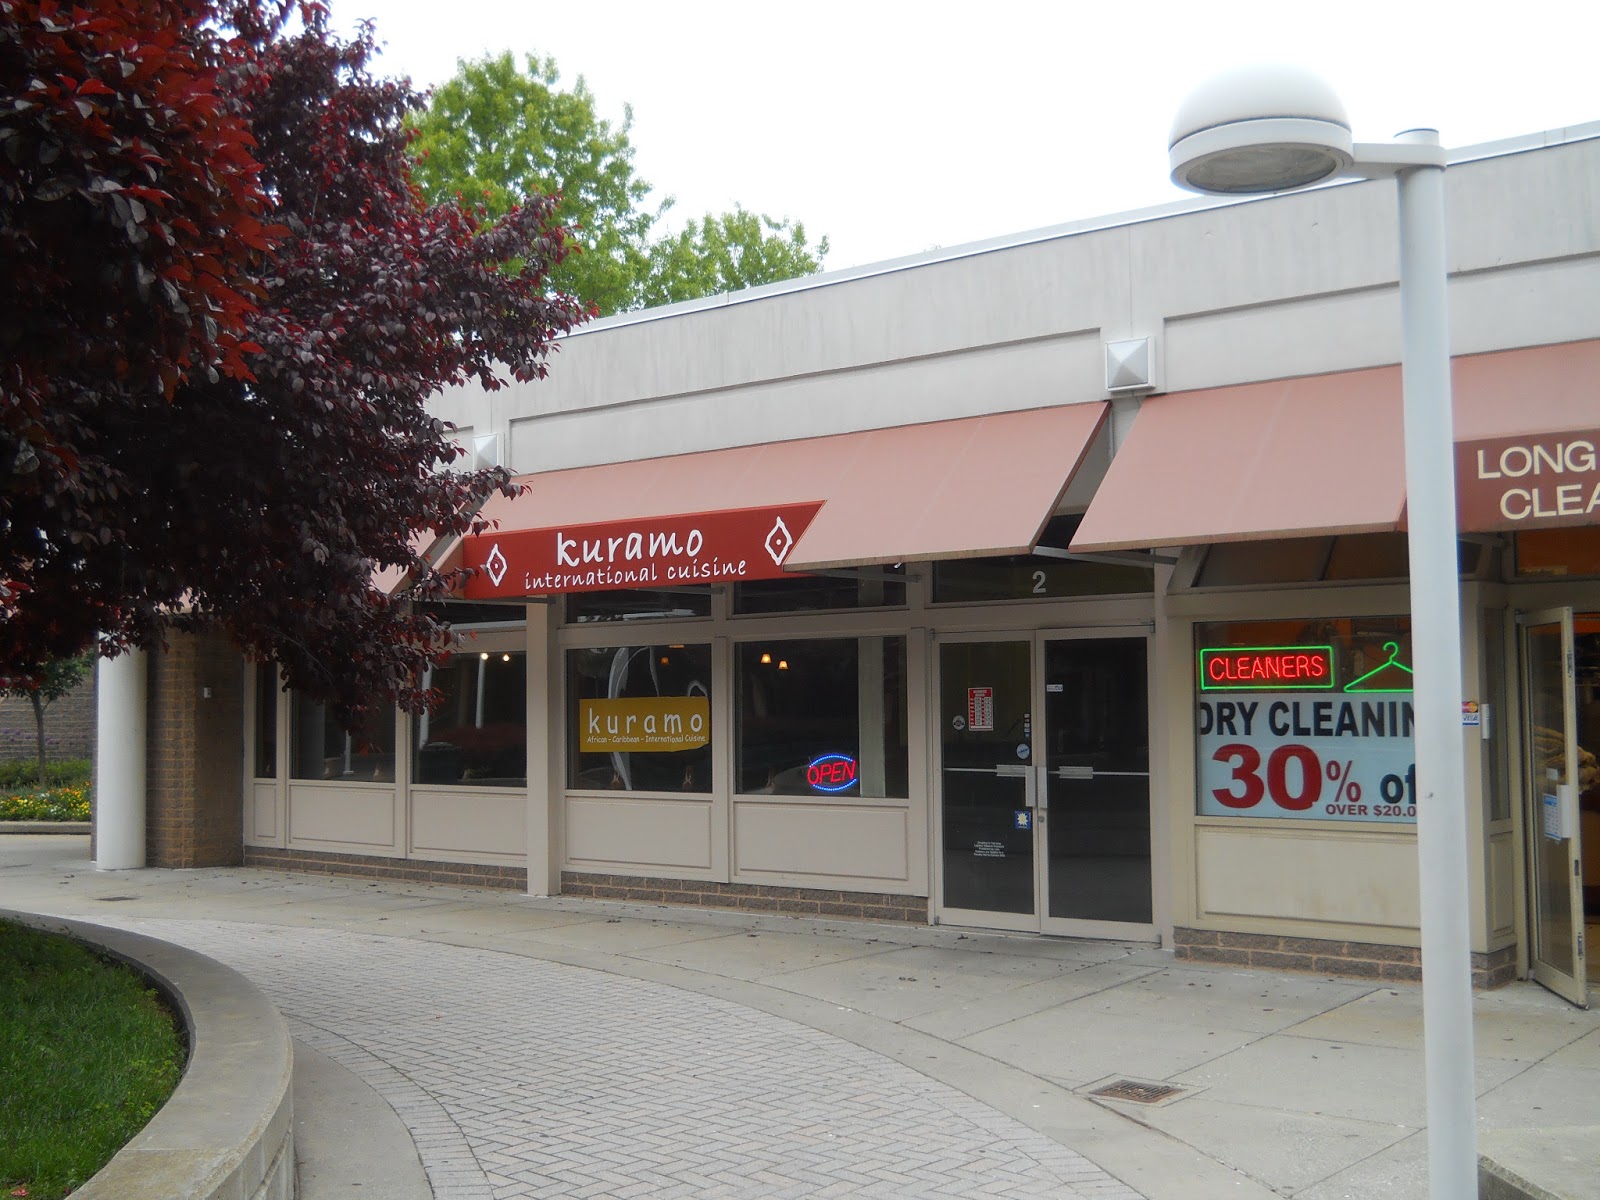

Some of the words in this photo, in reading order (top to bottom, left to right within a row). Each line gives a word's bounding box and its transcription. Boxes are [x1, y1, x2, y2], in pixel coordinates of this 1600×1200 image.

[1477, 441, 1596, 479] LONG
[556, 528, 703, 567] kuramo
[525, 564, 658, 590] international
[667, 557, 746, 579] cuisine
[1032, 570, 1047, 594] 2
[1209, 655, 1324, 681] CLEANERS
[589, 708, 703, 734] kuramo
[1200, 701, 1259, 736] DRY
[587, 735, 607, 743] African
[612, 735, 640, 743] Caribbean
[645, 735, 684, 744] International
[685, 734, 706, 742] Cuisine
[807, 760, 857, 785] OPEN
[1326, 804, 1368, 816] OVER
